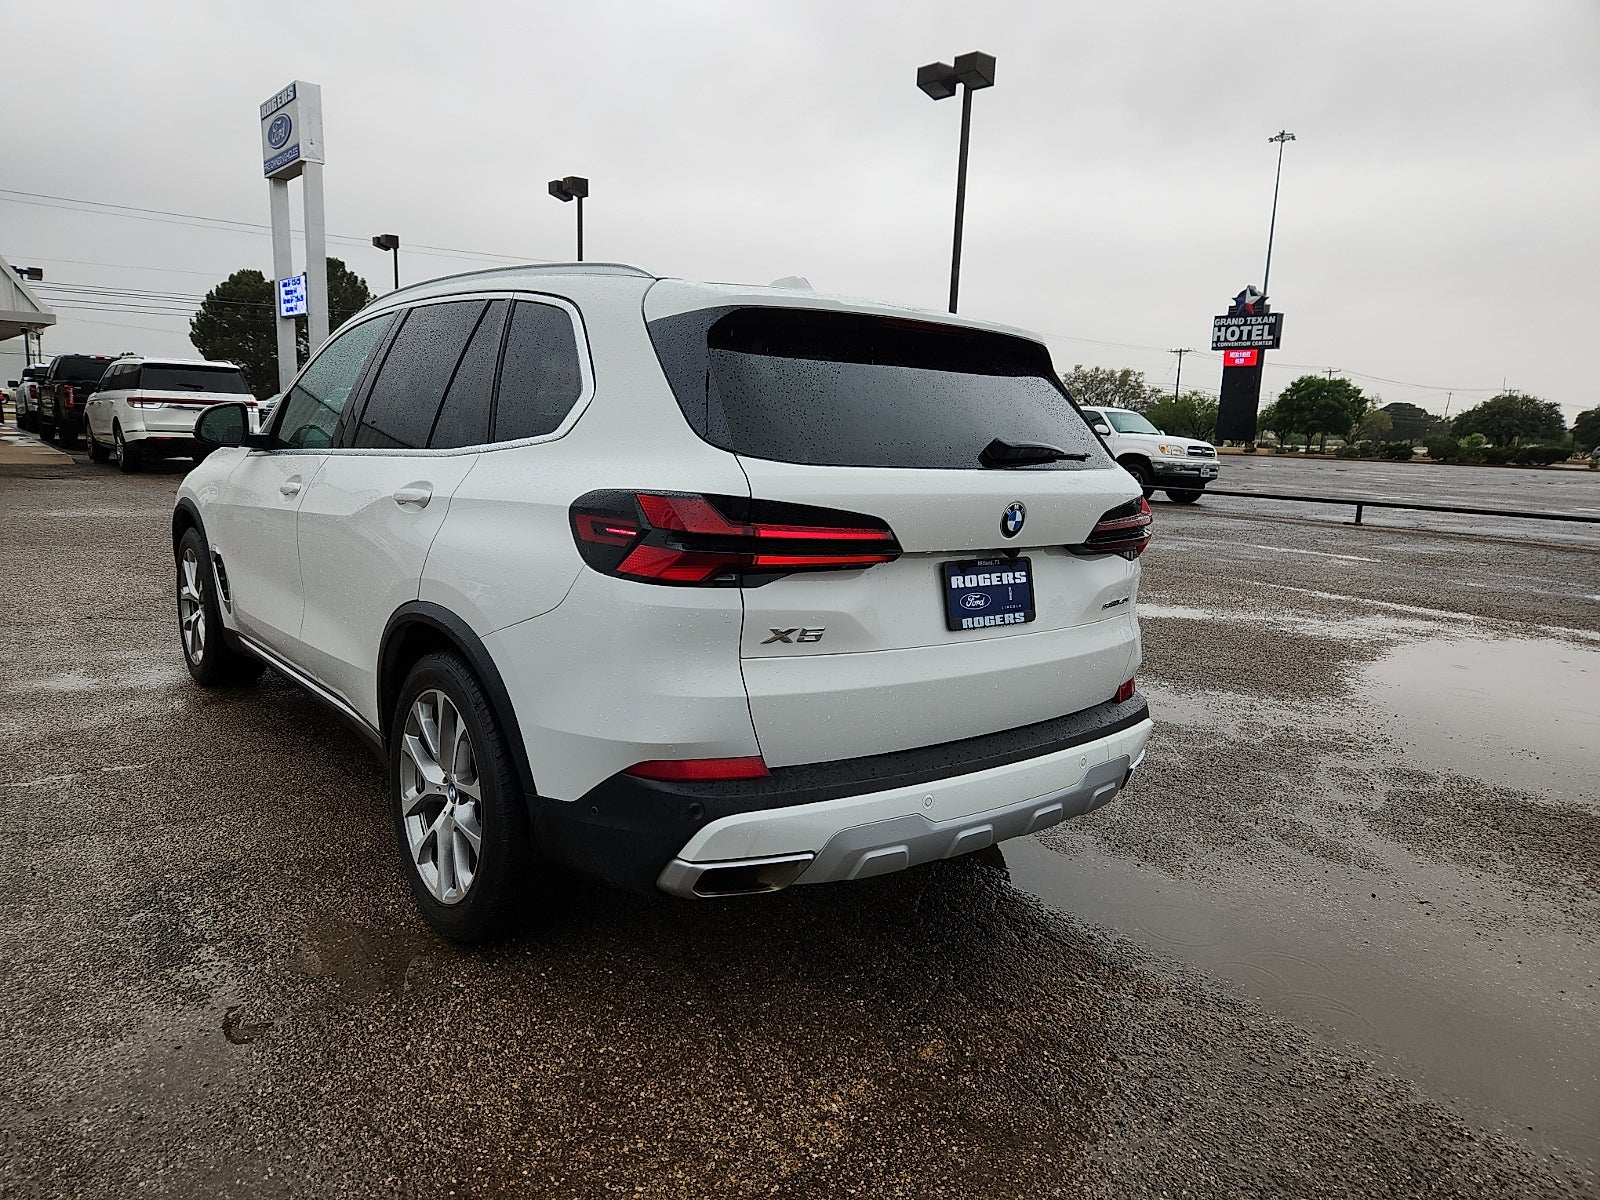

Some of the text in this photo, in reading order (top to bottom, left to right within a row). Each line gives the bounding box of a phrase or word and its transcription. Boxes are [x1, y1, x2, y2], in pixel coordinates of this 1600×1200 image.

[261, 86, 294, 119] ROGERS
[1214, 316, 1276, 326] GRAND TEXAN
[1212, 325, 1274, 341] HOTEL
[950, 571, 1027, 589] ROGERS
[965, 594, 986, 607] Ford
[962, 612, 1025, 629] ROGERS
[760, 627, 826, 645] X5
